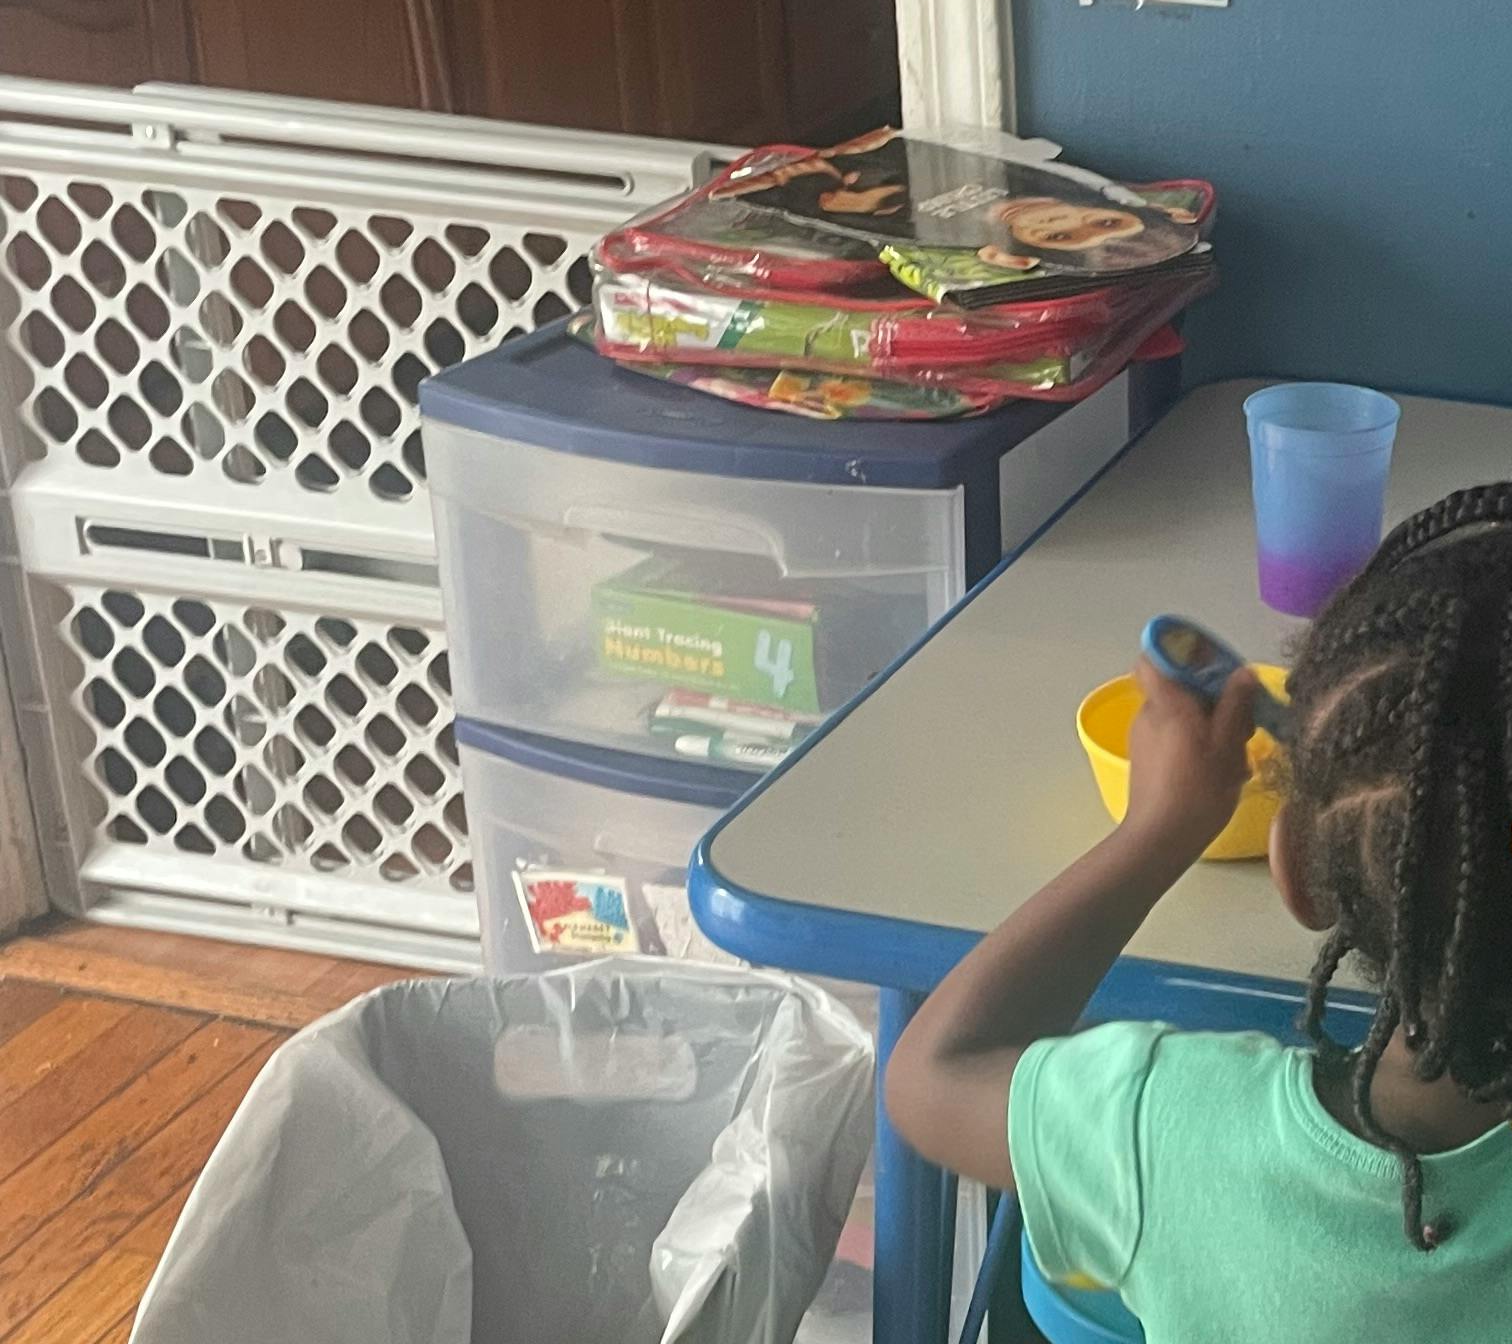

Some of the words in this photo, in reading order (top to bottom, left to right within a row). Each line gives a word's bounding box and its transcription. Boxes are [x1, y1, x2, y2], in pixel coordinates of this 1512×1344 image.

[604, 637, 725, 677] Numbers
[658, 629, 722, 657] Tracing
[754, 629, 794, 698] 4
